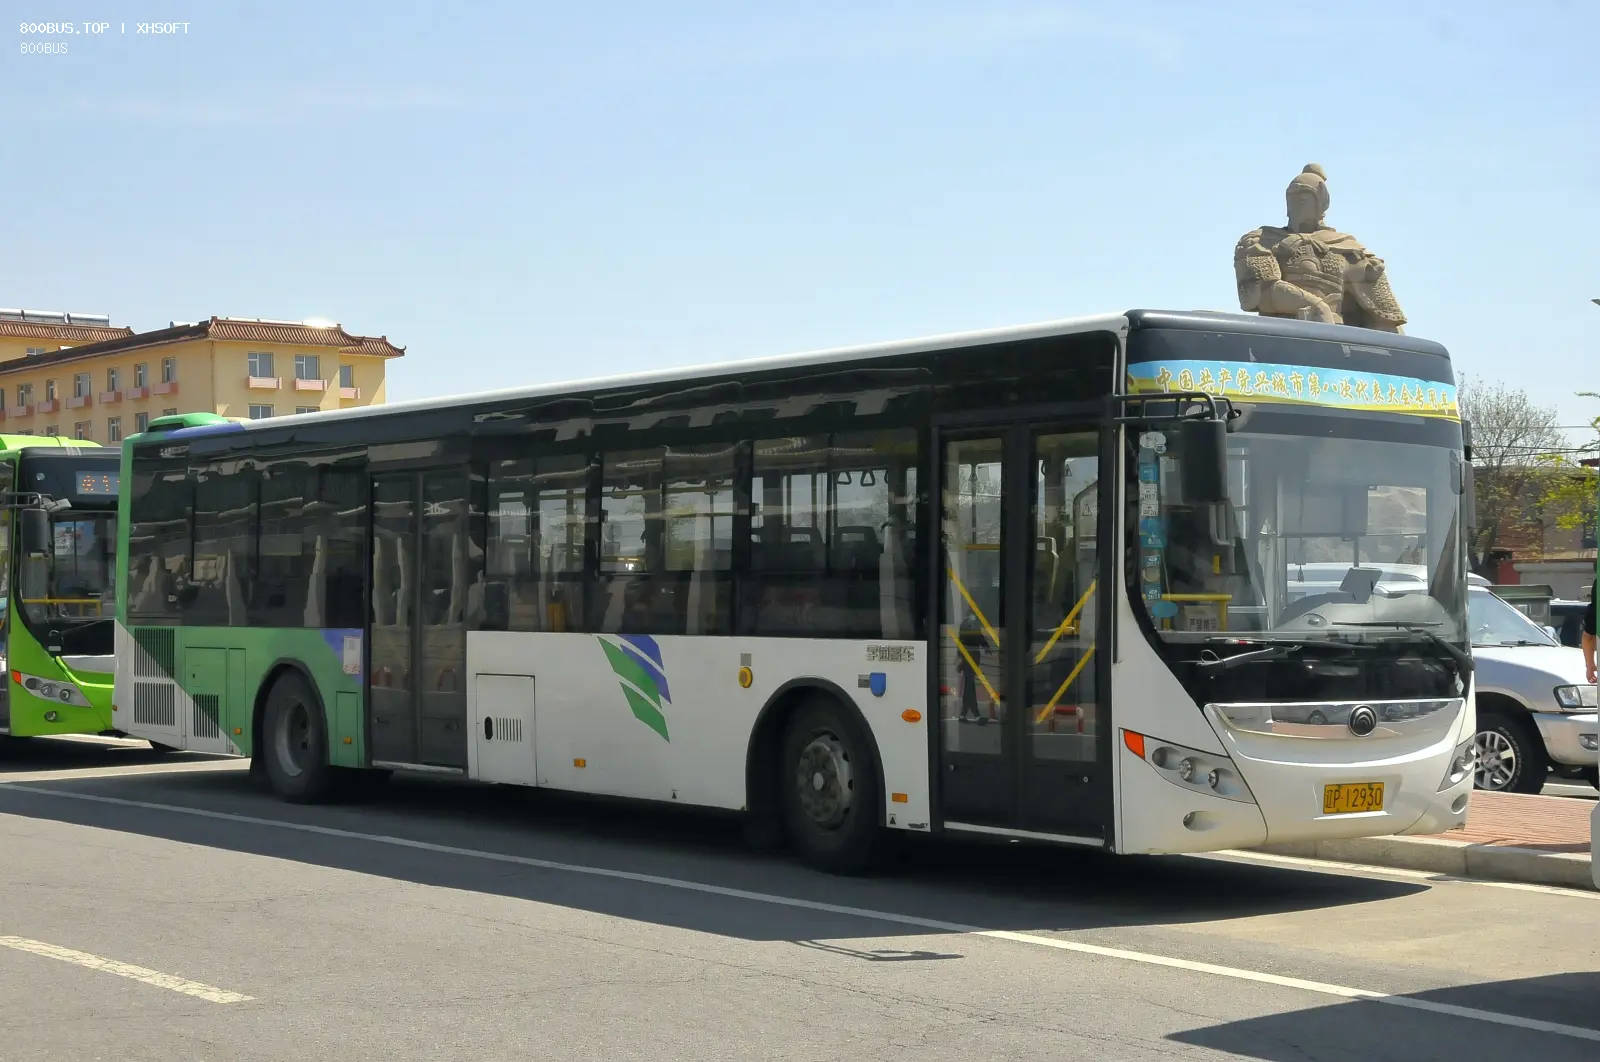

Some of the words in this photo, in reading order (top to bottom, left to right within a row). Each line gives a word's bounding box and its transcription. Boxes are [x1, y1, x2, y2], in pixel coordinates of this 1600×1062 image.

[1155, 366, 1450, 415] 中国共产党兴城市第八次代表大会专用车
